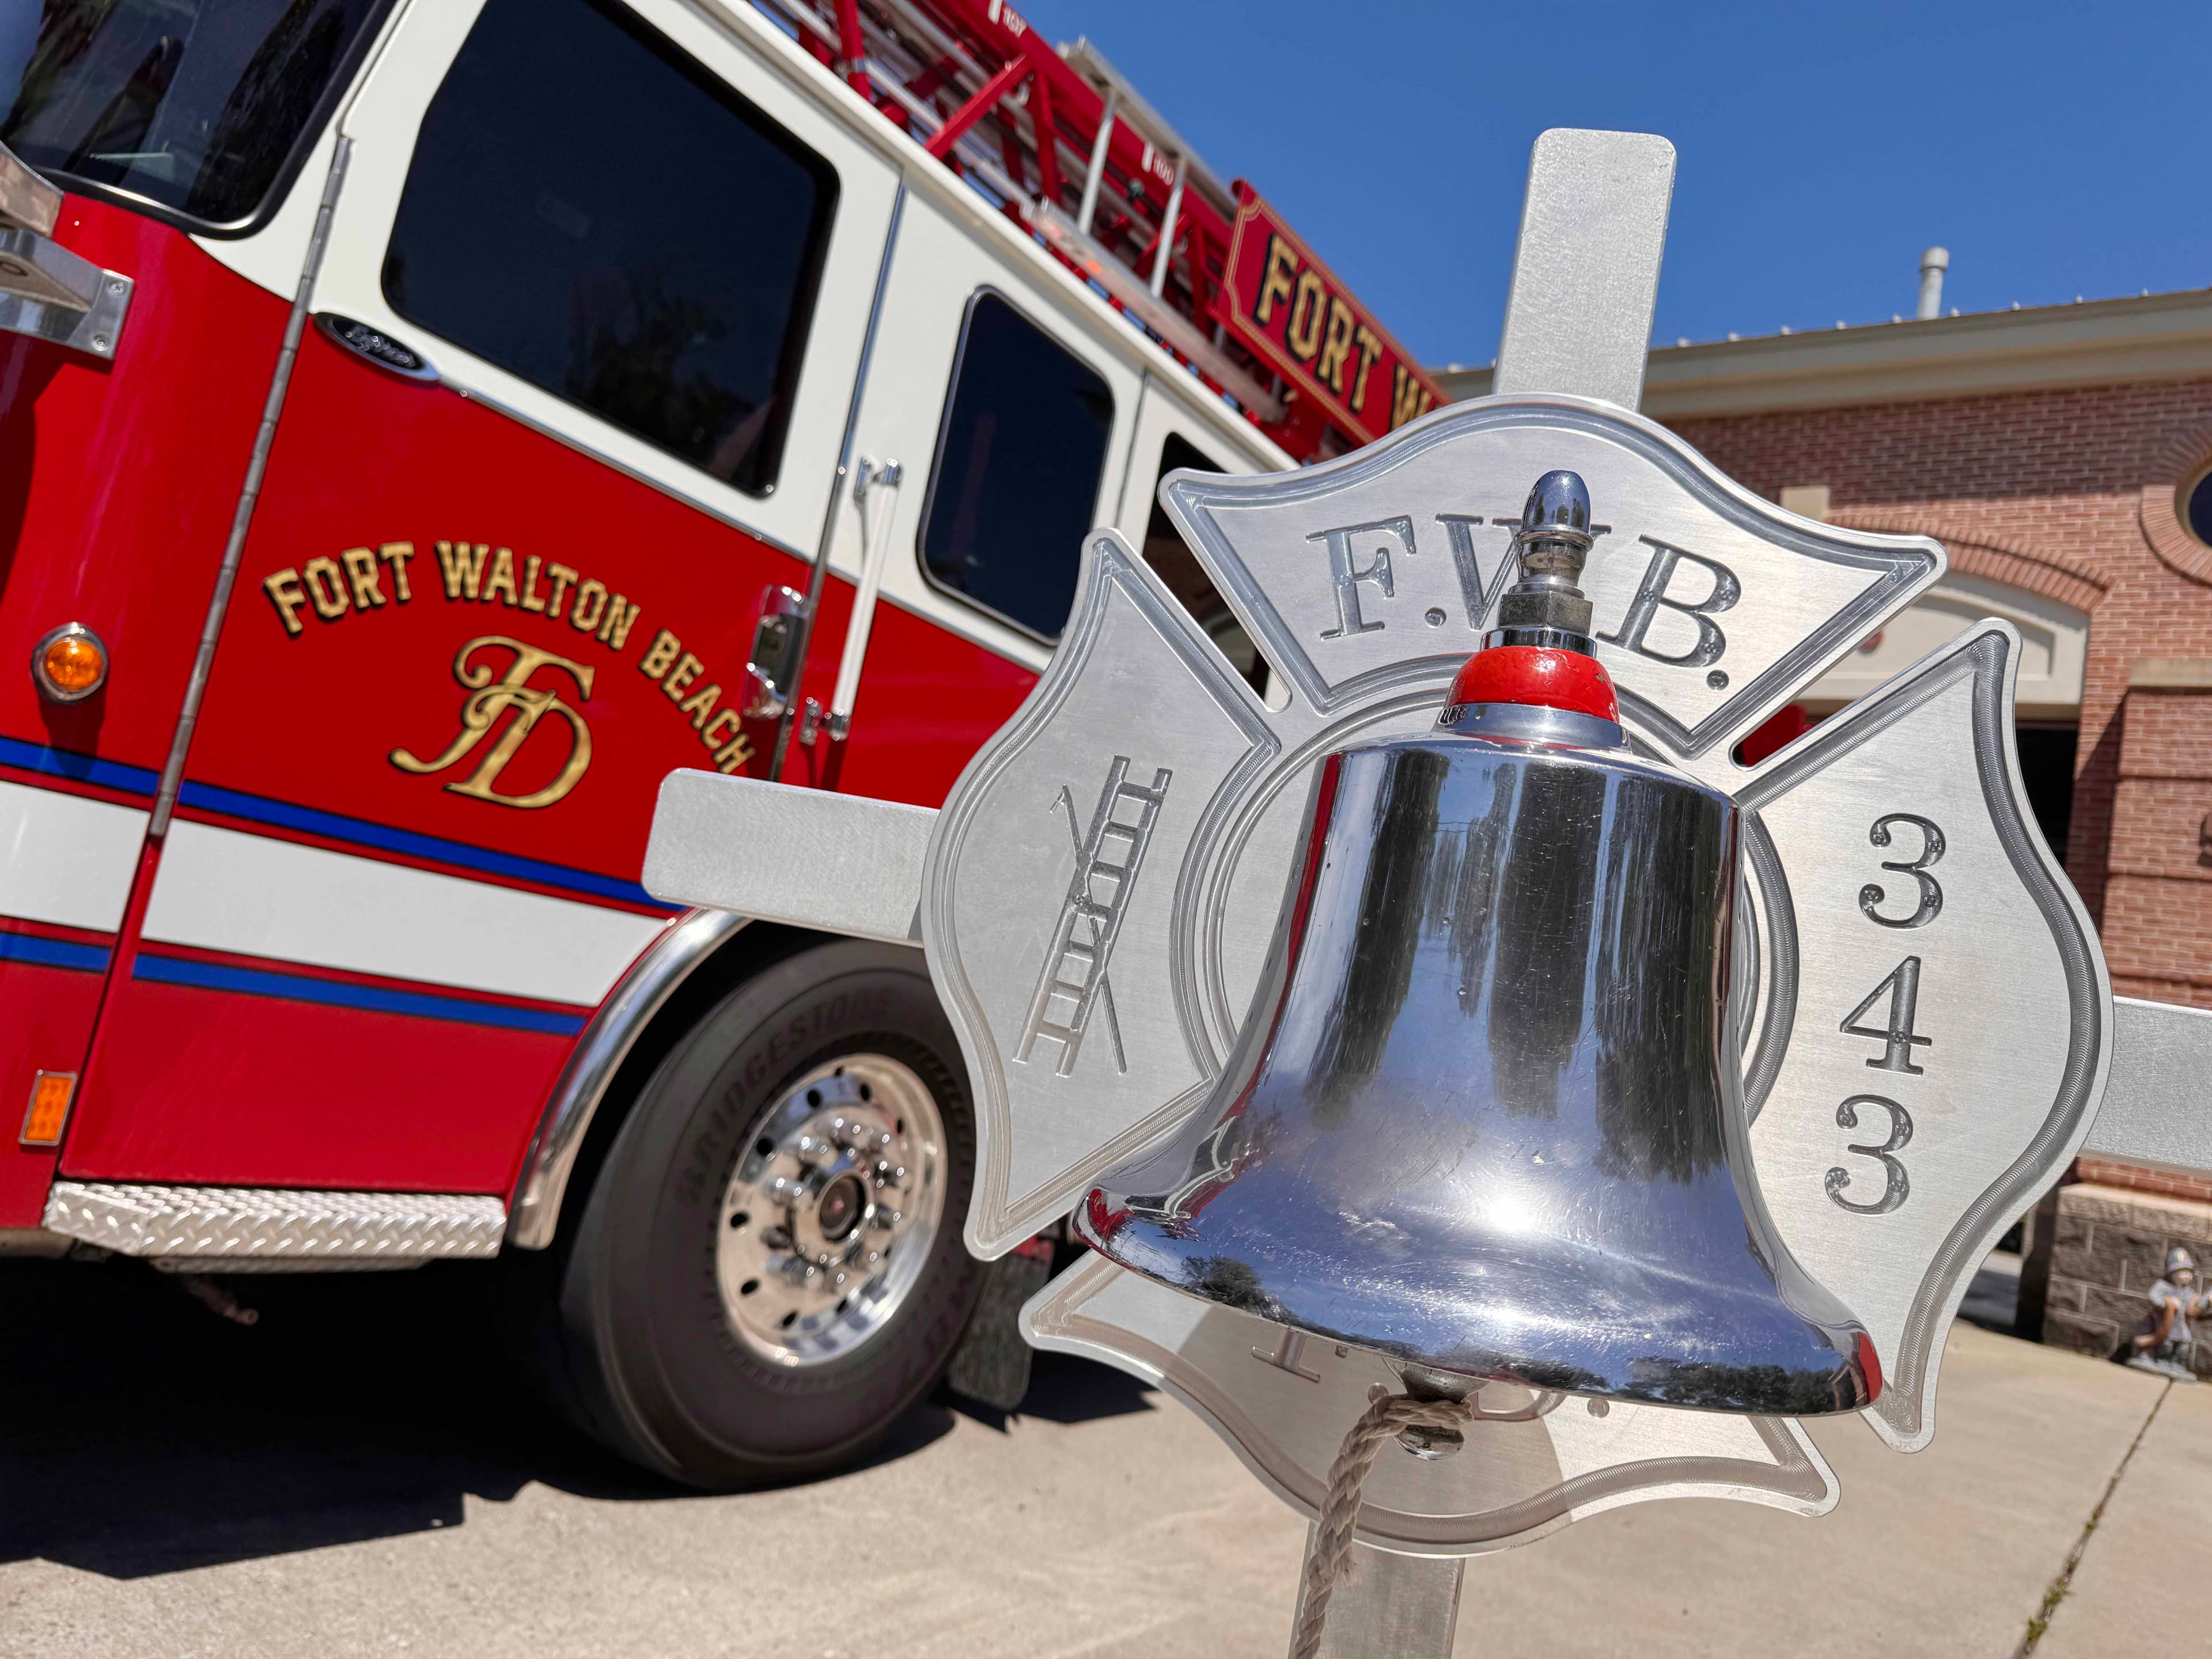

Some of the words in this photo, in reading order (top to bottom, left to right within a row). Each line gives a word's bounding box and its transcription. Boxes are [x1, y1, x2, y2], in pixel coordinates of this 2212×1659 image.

[1253, 232, 1382, 415] FORT
[263, 540, 415, 640] FORT
[435, 540, 641, 652] WALTON
[638, 628, 756, 775] BEACH
